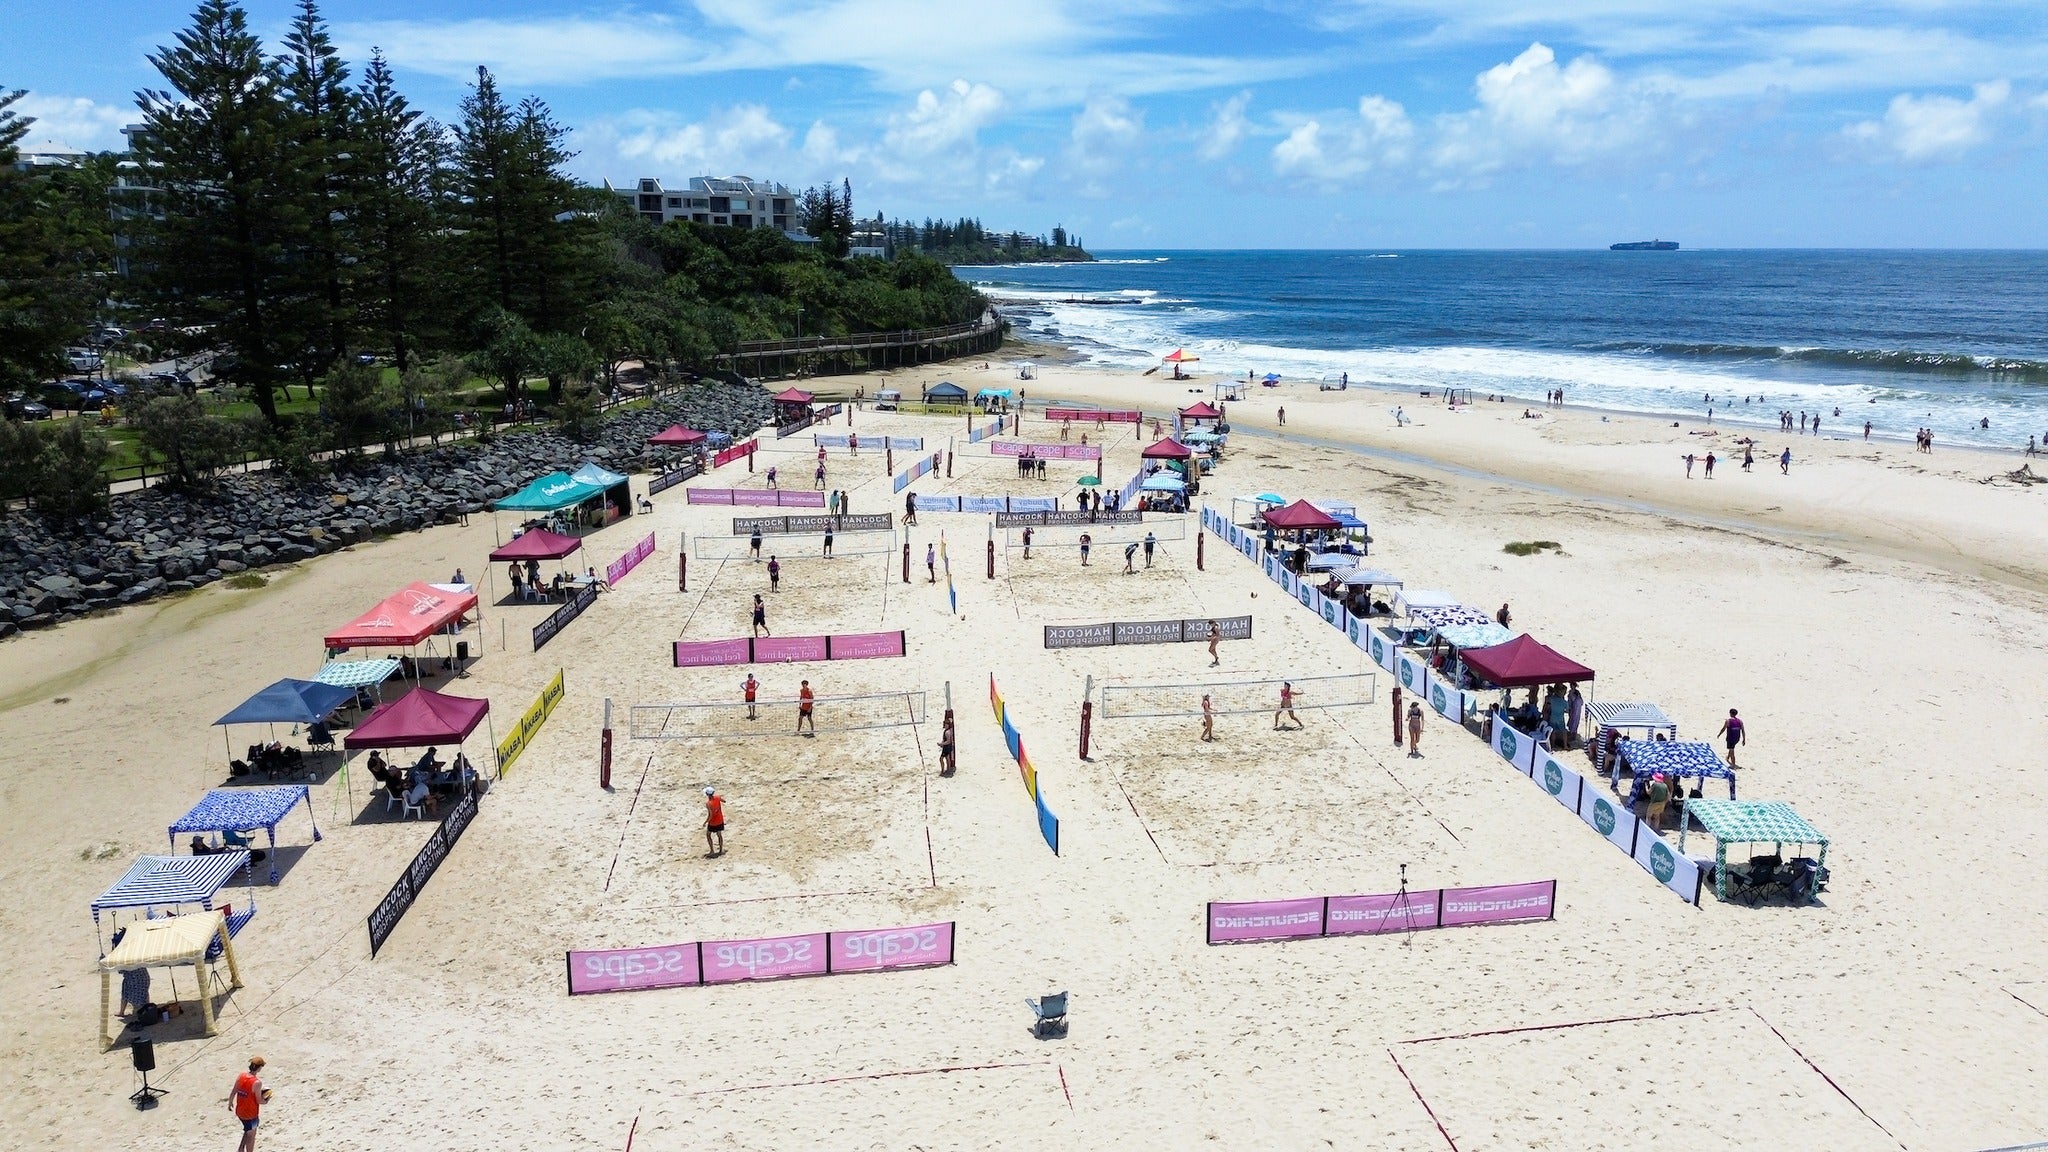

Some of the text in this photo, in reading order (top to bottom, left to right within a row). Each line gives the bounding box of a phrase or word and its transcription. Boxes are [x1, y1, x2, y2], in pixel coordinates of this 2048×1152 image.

[996, 443, 1024, 454] scape
[1032, 445, 1060, 456] scape
[1069, 447, 1097, 457] scape
[790, 517, 836, 525] HANCOCK
[1000, 513, 1043, 521] HANCOCK
[1048, 512, 1090, 520] HANCOCK
[736, 520, 784, 528] HANCOCK
[445, 789, 473, 834] HANCOCK
[447, 802, 475, 844] PROSPECTING
[411, 829, 444, 879] HANCOCK
[413, 844, 445, 891] PROSPECTING
[371, 875, 409, 933] HANCOCK
[373, 891, 411, 944] PROSPECTING
